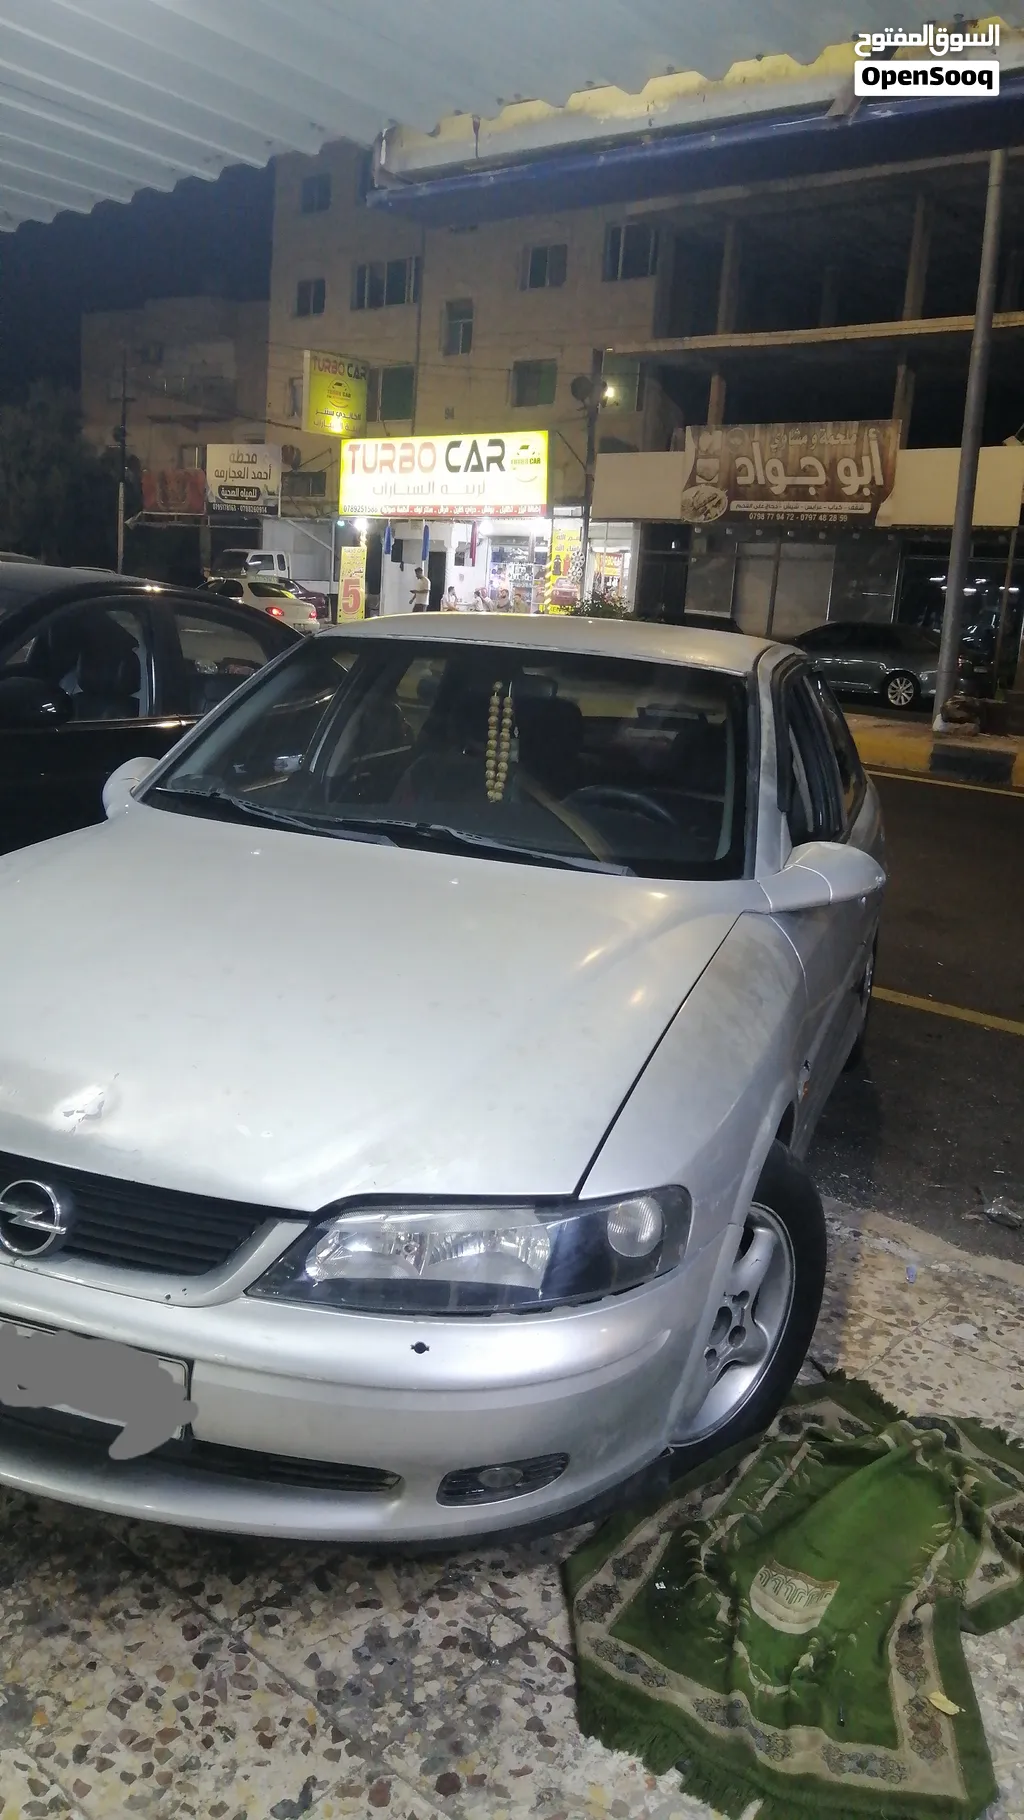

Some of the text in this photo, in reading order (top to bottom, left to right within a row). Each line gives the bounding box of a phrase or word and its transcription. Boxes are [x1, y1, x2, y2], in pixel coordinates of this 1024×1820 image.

[313, 356, 367, 380] TURBO CAR
[770, 428, 808, 452] مشاوي
[820, 428, 858, 446] ملحمة
[348, 438, 506, 475] TURBO CAR
[734, 441, 826, 496] جواد
[251, 464, 272, 481] أحمد
[220, 487, 257, 500] للمياه الصحية
[786, 513, 794, 521] 72
[342, 578, 361, 615] 5
